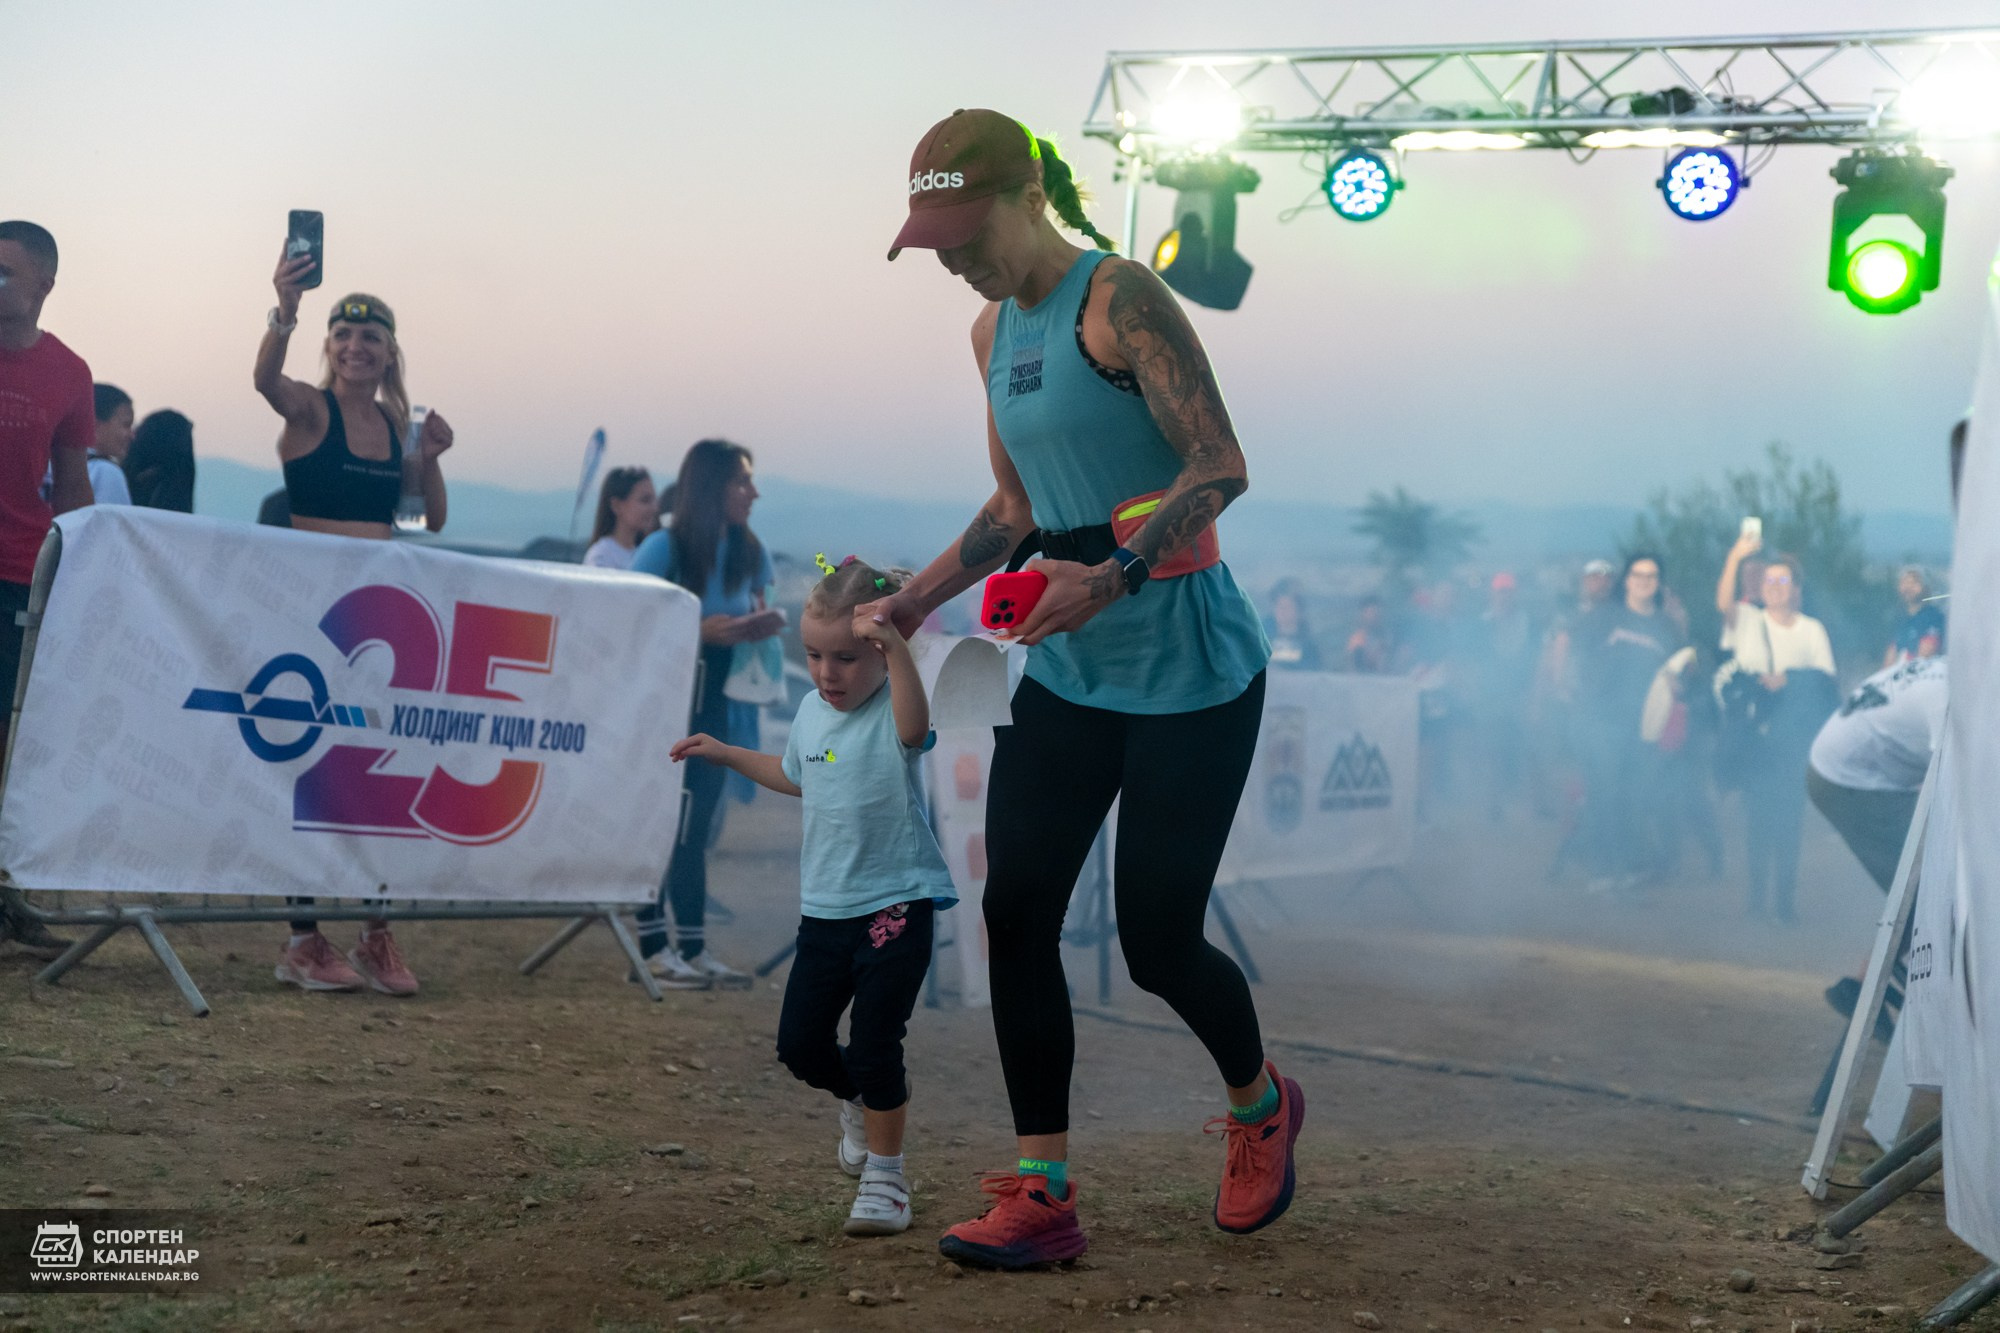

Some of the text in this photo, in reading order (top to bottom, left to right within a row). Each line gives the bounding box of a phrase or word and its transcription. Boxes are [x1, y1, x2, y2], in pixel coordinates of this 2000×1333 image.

[909, 168, 964, 195] didas
[1008, 374, 1042, 397] GYMSHARK
[292, 583, 557, 847] 25
[389, 704, 586, 753] ХОЛДИНГ КЦМ 2000
